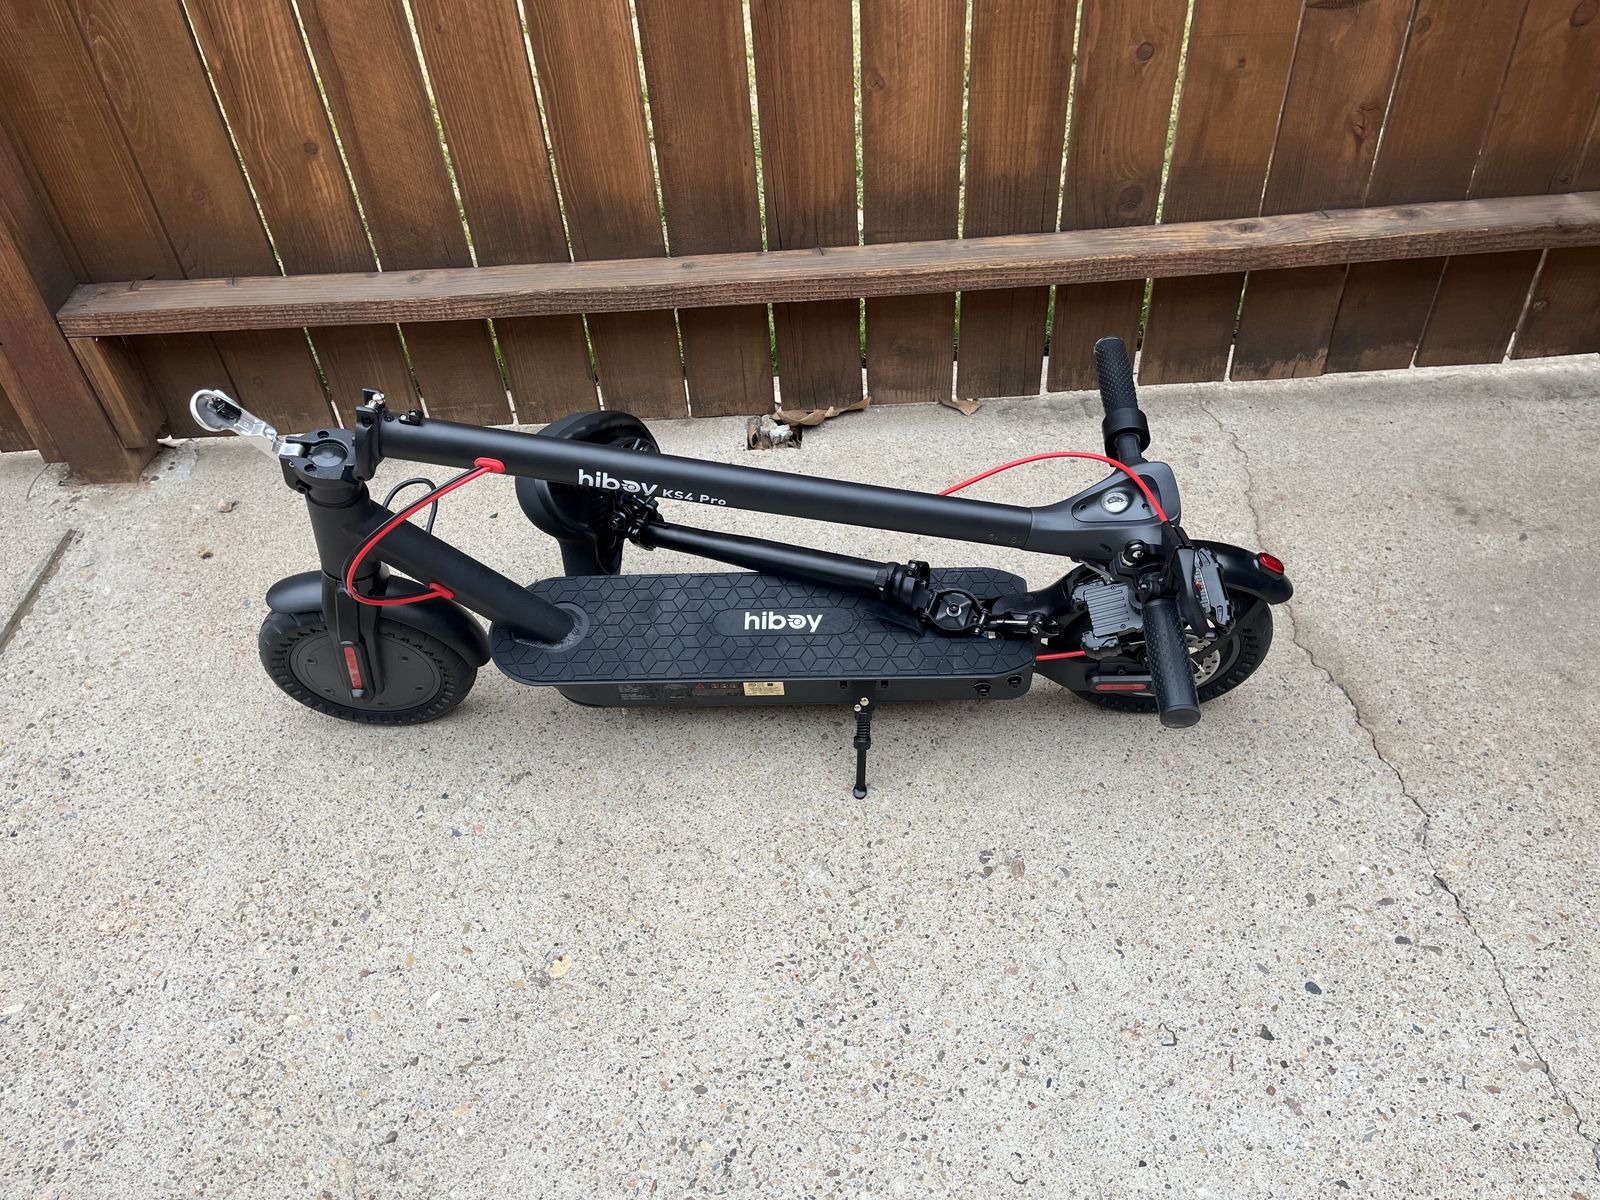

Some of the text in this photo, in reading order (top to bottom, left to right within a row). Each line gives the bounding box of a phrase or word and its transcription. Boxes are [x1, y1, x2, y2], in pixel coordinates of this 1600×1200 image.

[578, 468, 727, 506] hiboy KS4 Pro
[744, 611, 823, 633] hiboy
